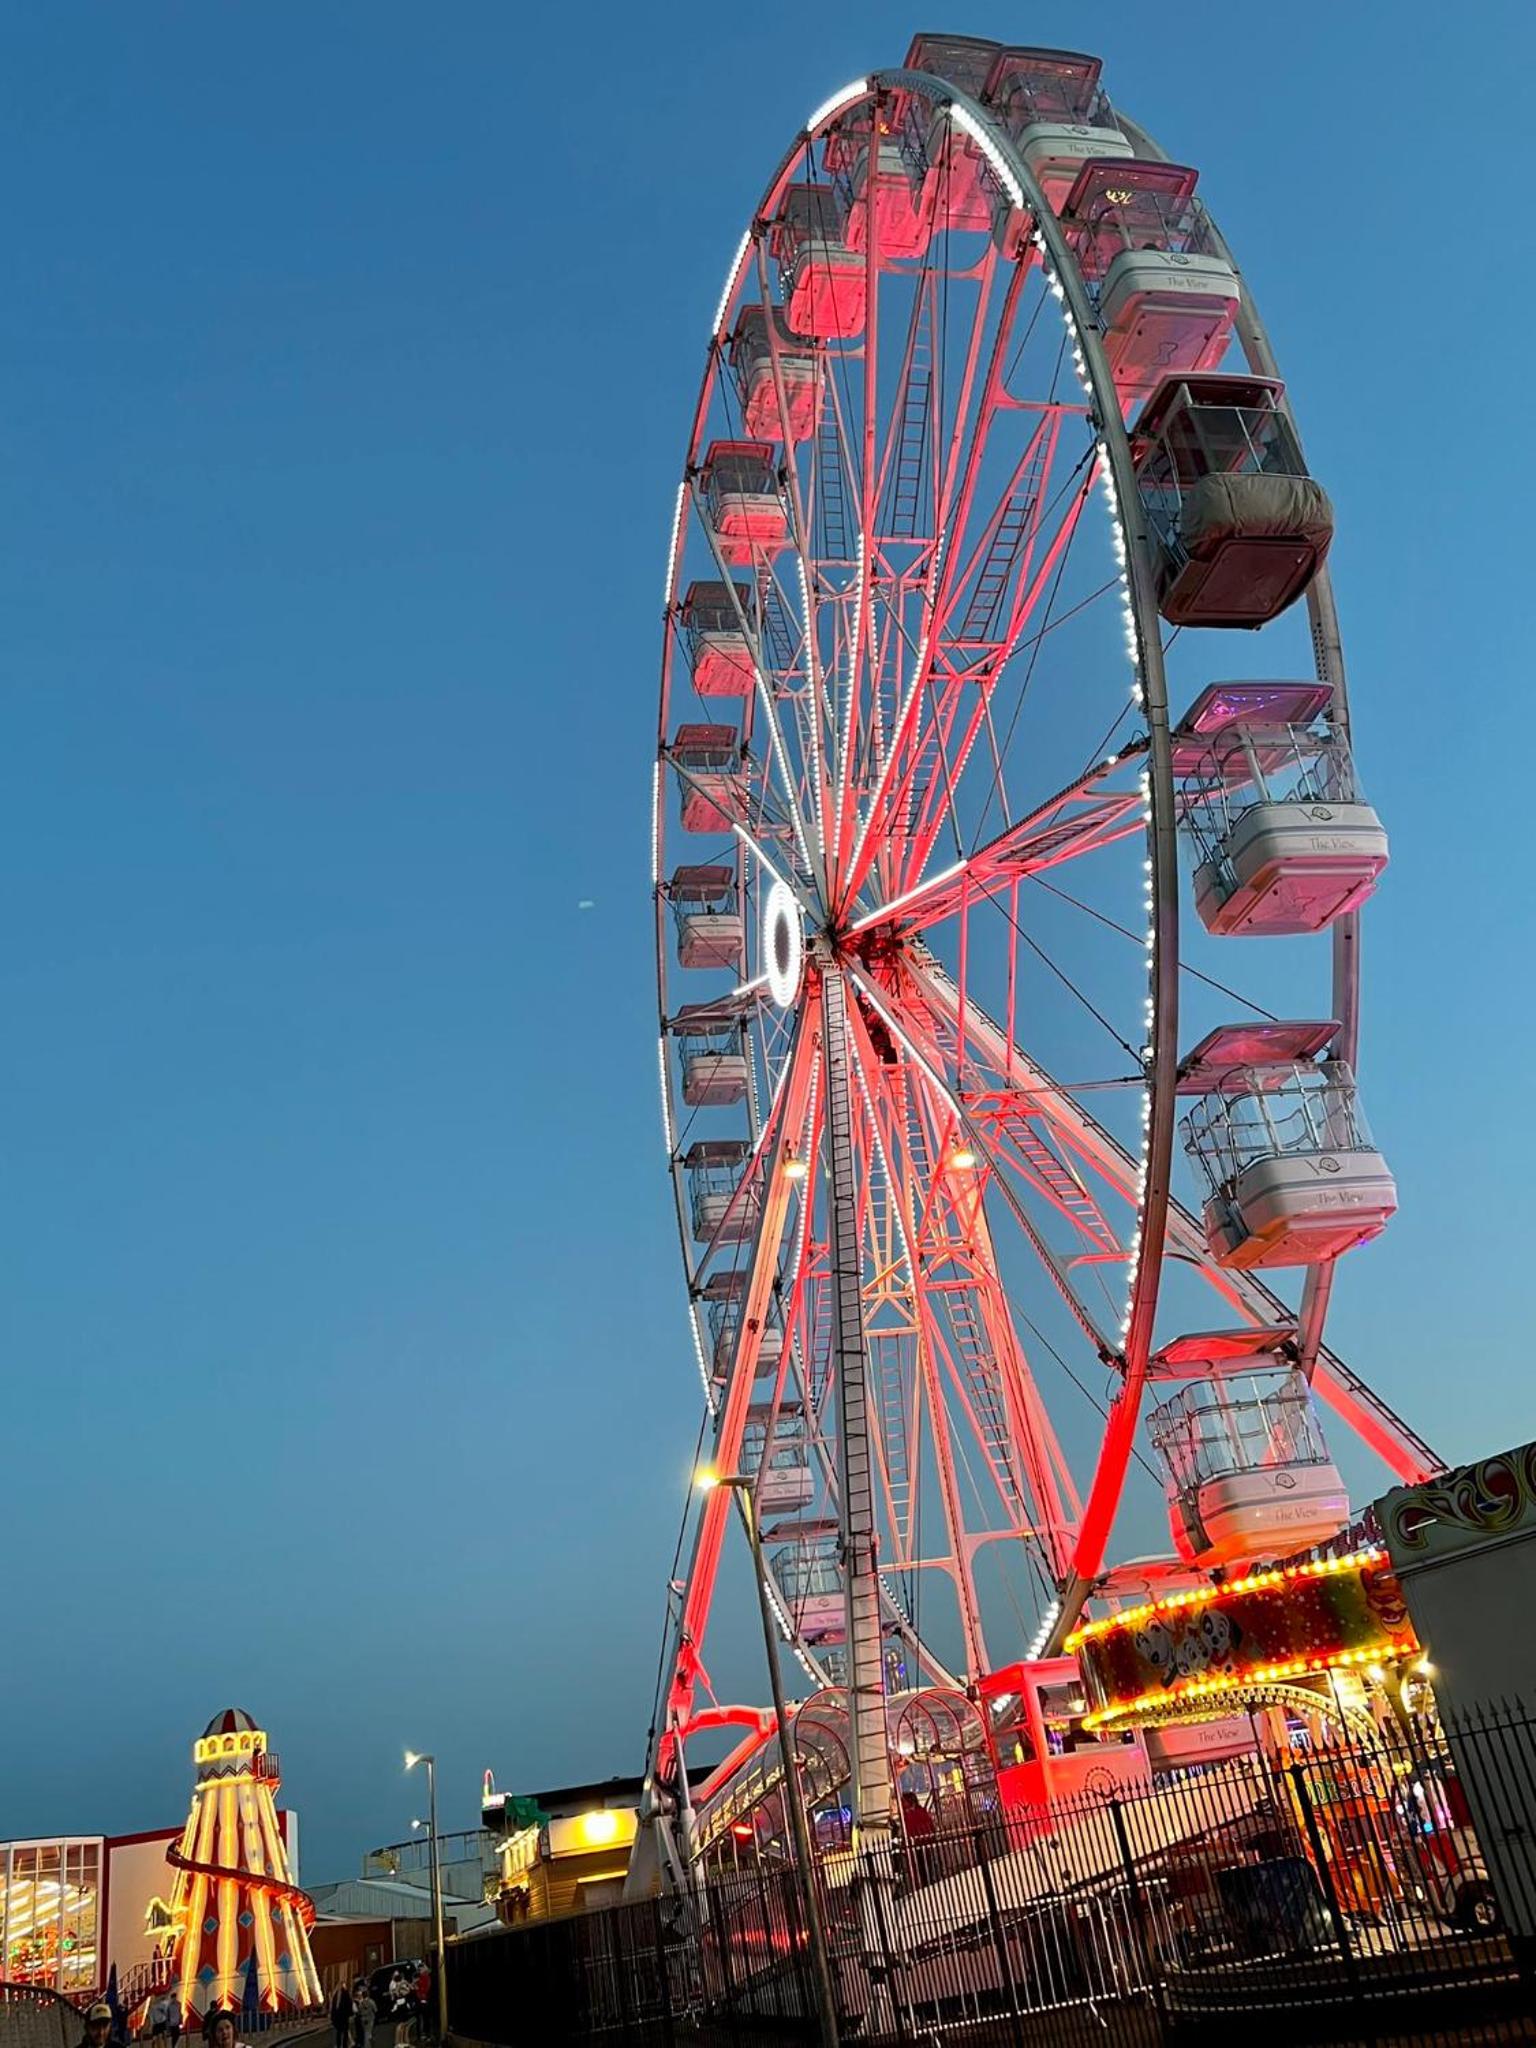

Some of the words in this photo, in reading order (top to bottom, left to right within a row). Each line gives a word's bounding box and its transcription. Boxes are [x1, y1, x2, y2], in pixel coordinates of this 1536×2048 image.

[1316, 1192, 1337, 1204] The
[1338, 1190, 1364, 1203] View
[1198, 1730, 1215, 1741] The
[1216, 1728, 1239, 1740] View
